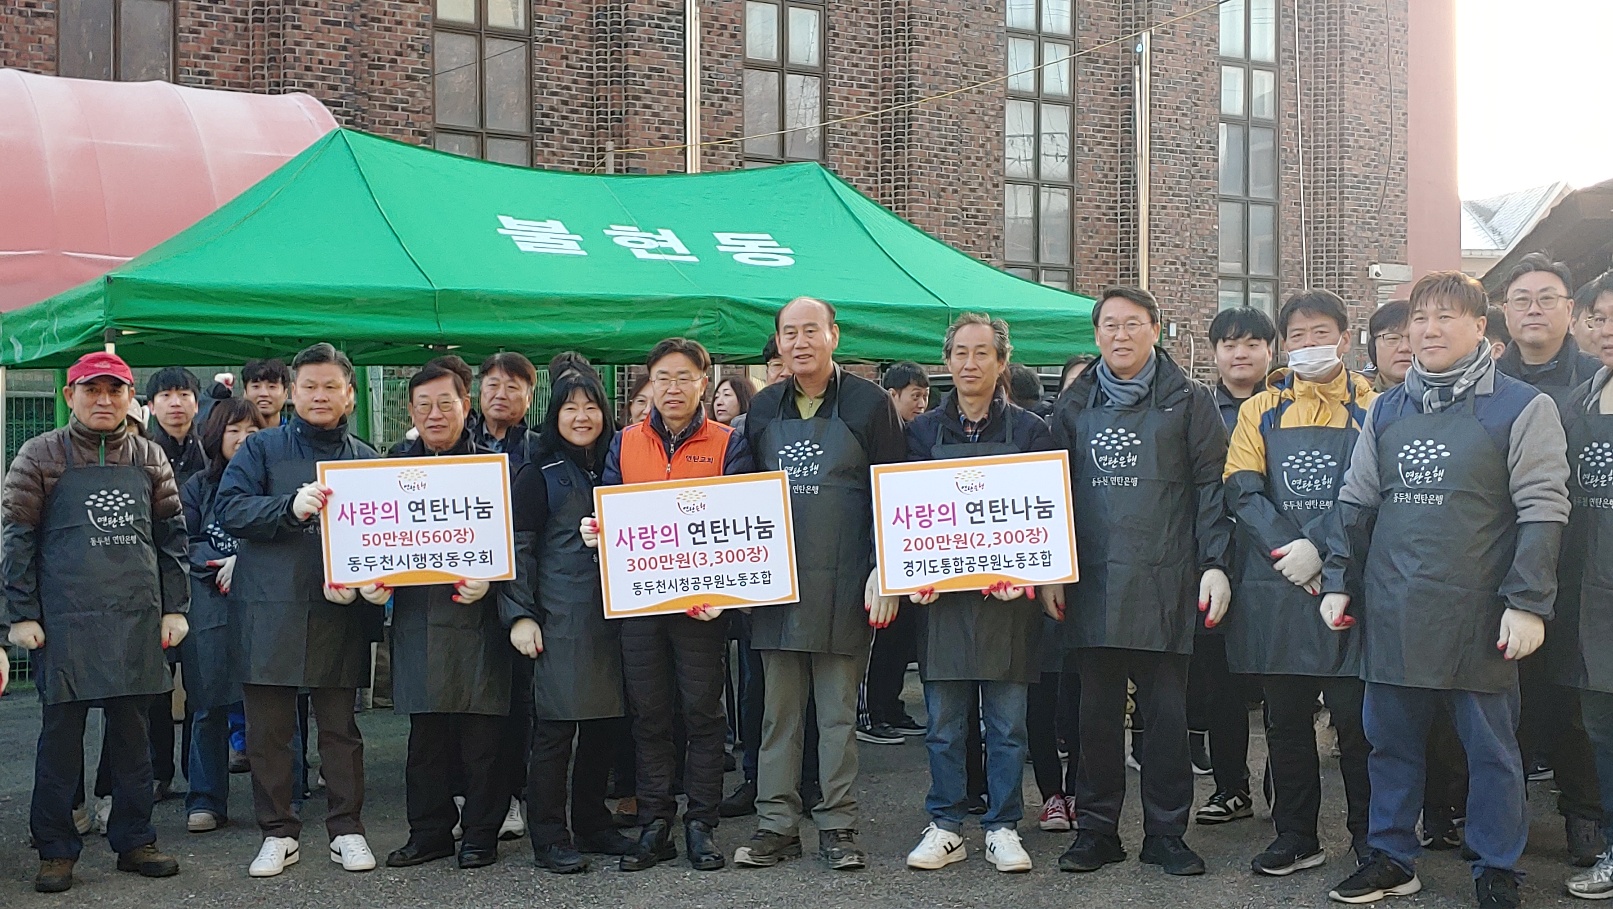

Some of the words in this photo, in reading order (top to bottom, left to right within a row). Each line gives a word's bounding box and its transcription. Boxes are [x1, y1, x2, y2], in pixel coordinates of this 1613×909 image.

[497, 215, 795, 267] 불현동
[784, 461, 819, 478] 연탄은행
[1098, 451, 1138, 469] 연탄은행
[1091, 476, 1108, 487] 동두천
[1110, 475, 1138, 487] 연탄은행
[1291, 474, 1333, 492] 연탄은행
[1405, 465, 1445, 485] 연탄은행
[792, 484, 819, 495] 연탄은행
[1393, 492, 1412, 504] 동두천
[1413, 493, 1444, 506] 연탄은행
[337, 500, 399, 527] 사랑의
[407, 496, 494, 523] 연탄나눔
[892, 501, 957, 530] 사랑의
[965, 495, 1056, 525] 연탄나눔
[1283, 500, 1303, 511] 동두천
[97, 511, 134, 528] 연탄은행
[362, 527, 475, 547] 50만원(560장)
[615, 522, 680, 552] 사랑의
[687, 515, 776, 546] 연탄나눔
[903, 526, 1049, 553] 200만원(2,300장)
[347, 549, 494, 573] 동두천시행정동우회
[626, 545, 769, 572] 300만원(3,300장)
[903, 549, 1053, 578] 경기도통합공무원노동조합
[632, 570, 773, 597] 동두천시청공무원노동조합
